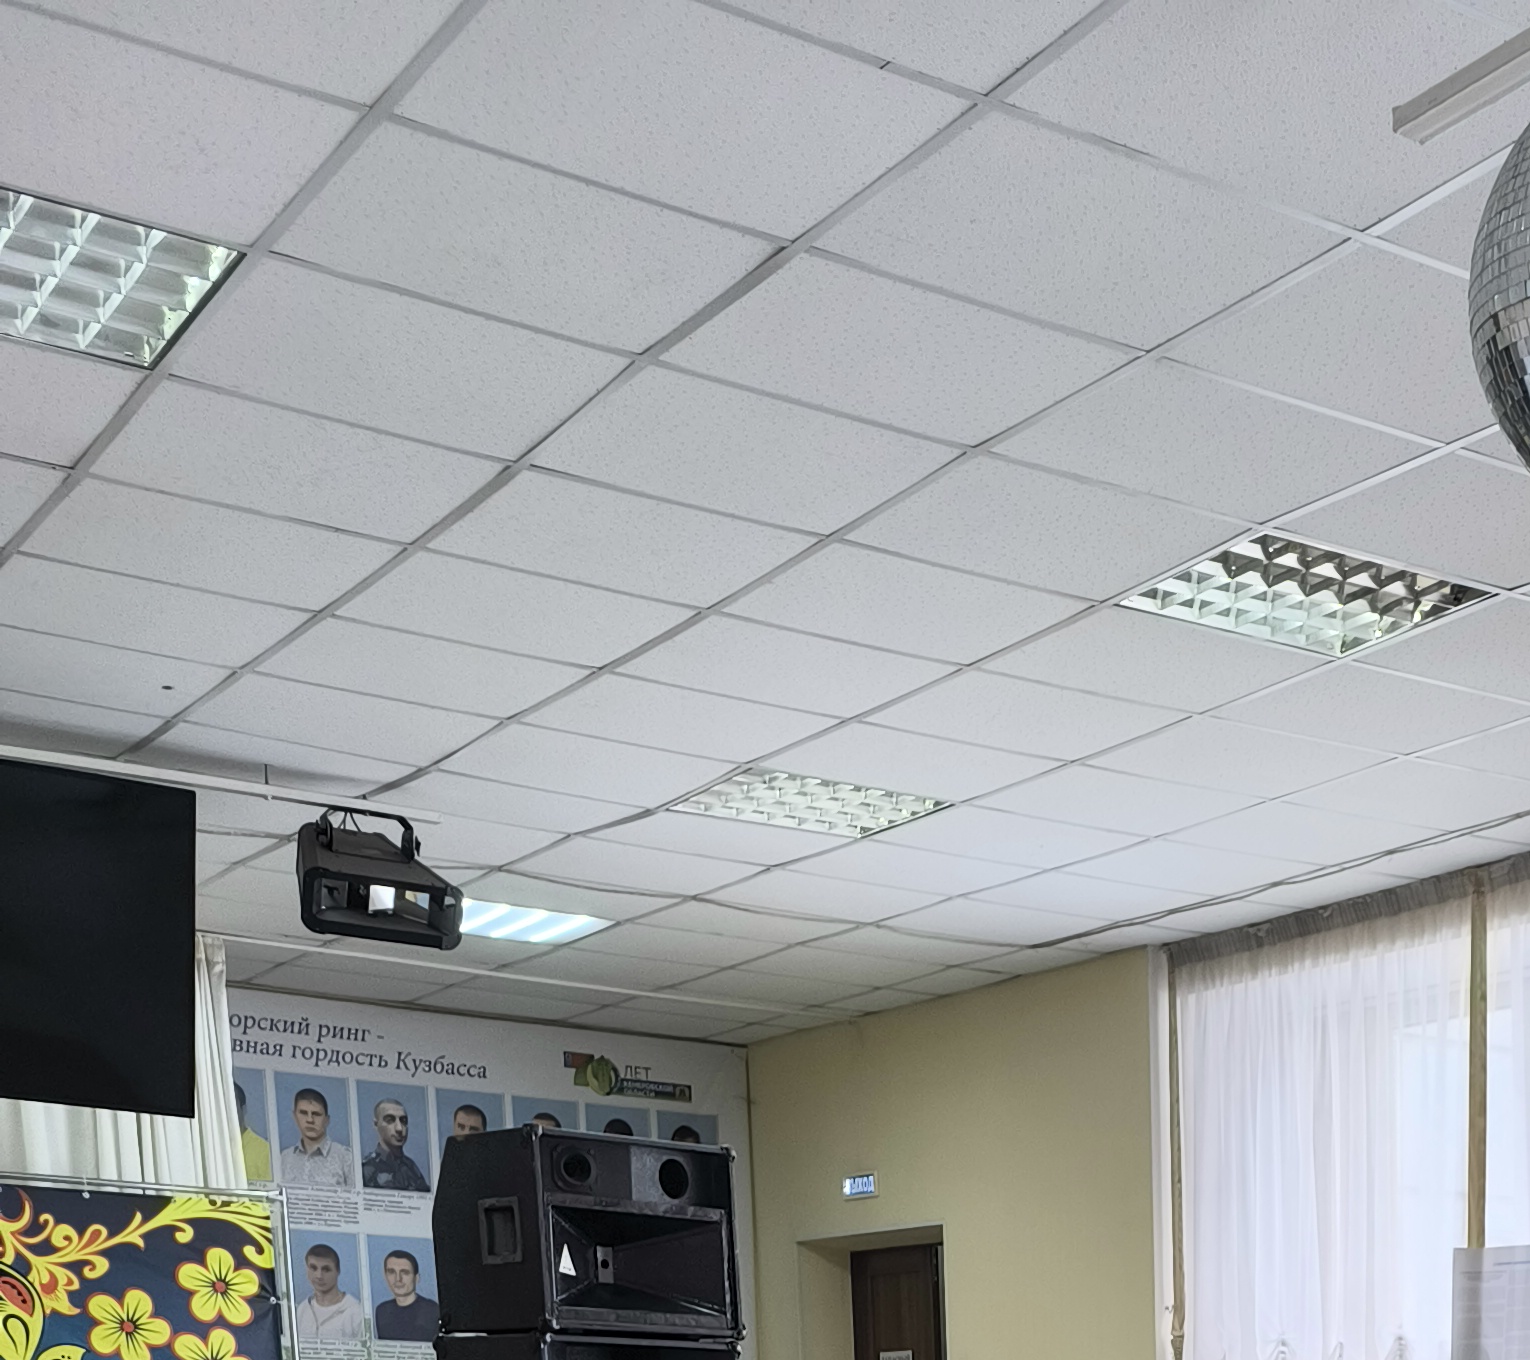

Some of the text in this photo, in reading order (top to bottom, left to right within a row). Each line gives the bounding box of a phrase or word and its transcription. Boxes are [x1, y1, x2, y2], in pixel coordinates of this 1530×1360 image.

[317, 1024, 371, 1043] ринг
[291, 1044, 389, 1069] гордость
[395, 1051, 488, 1079] Кузбасса
[624, 1065, 651, 1080] ЛЕТ
